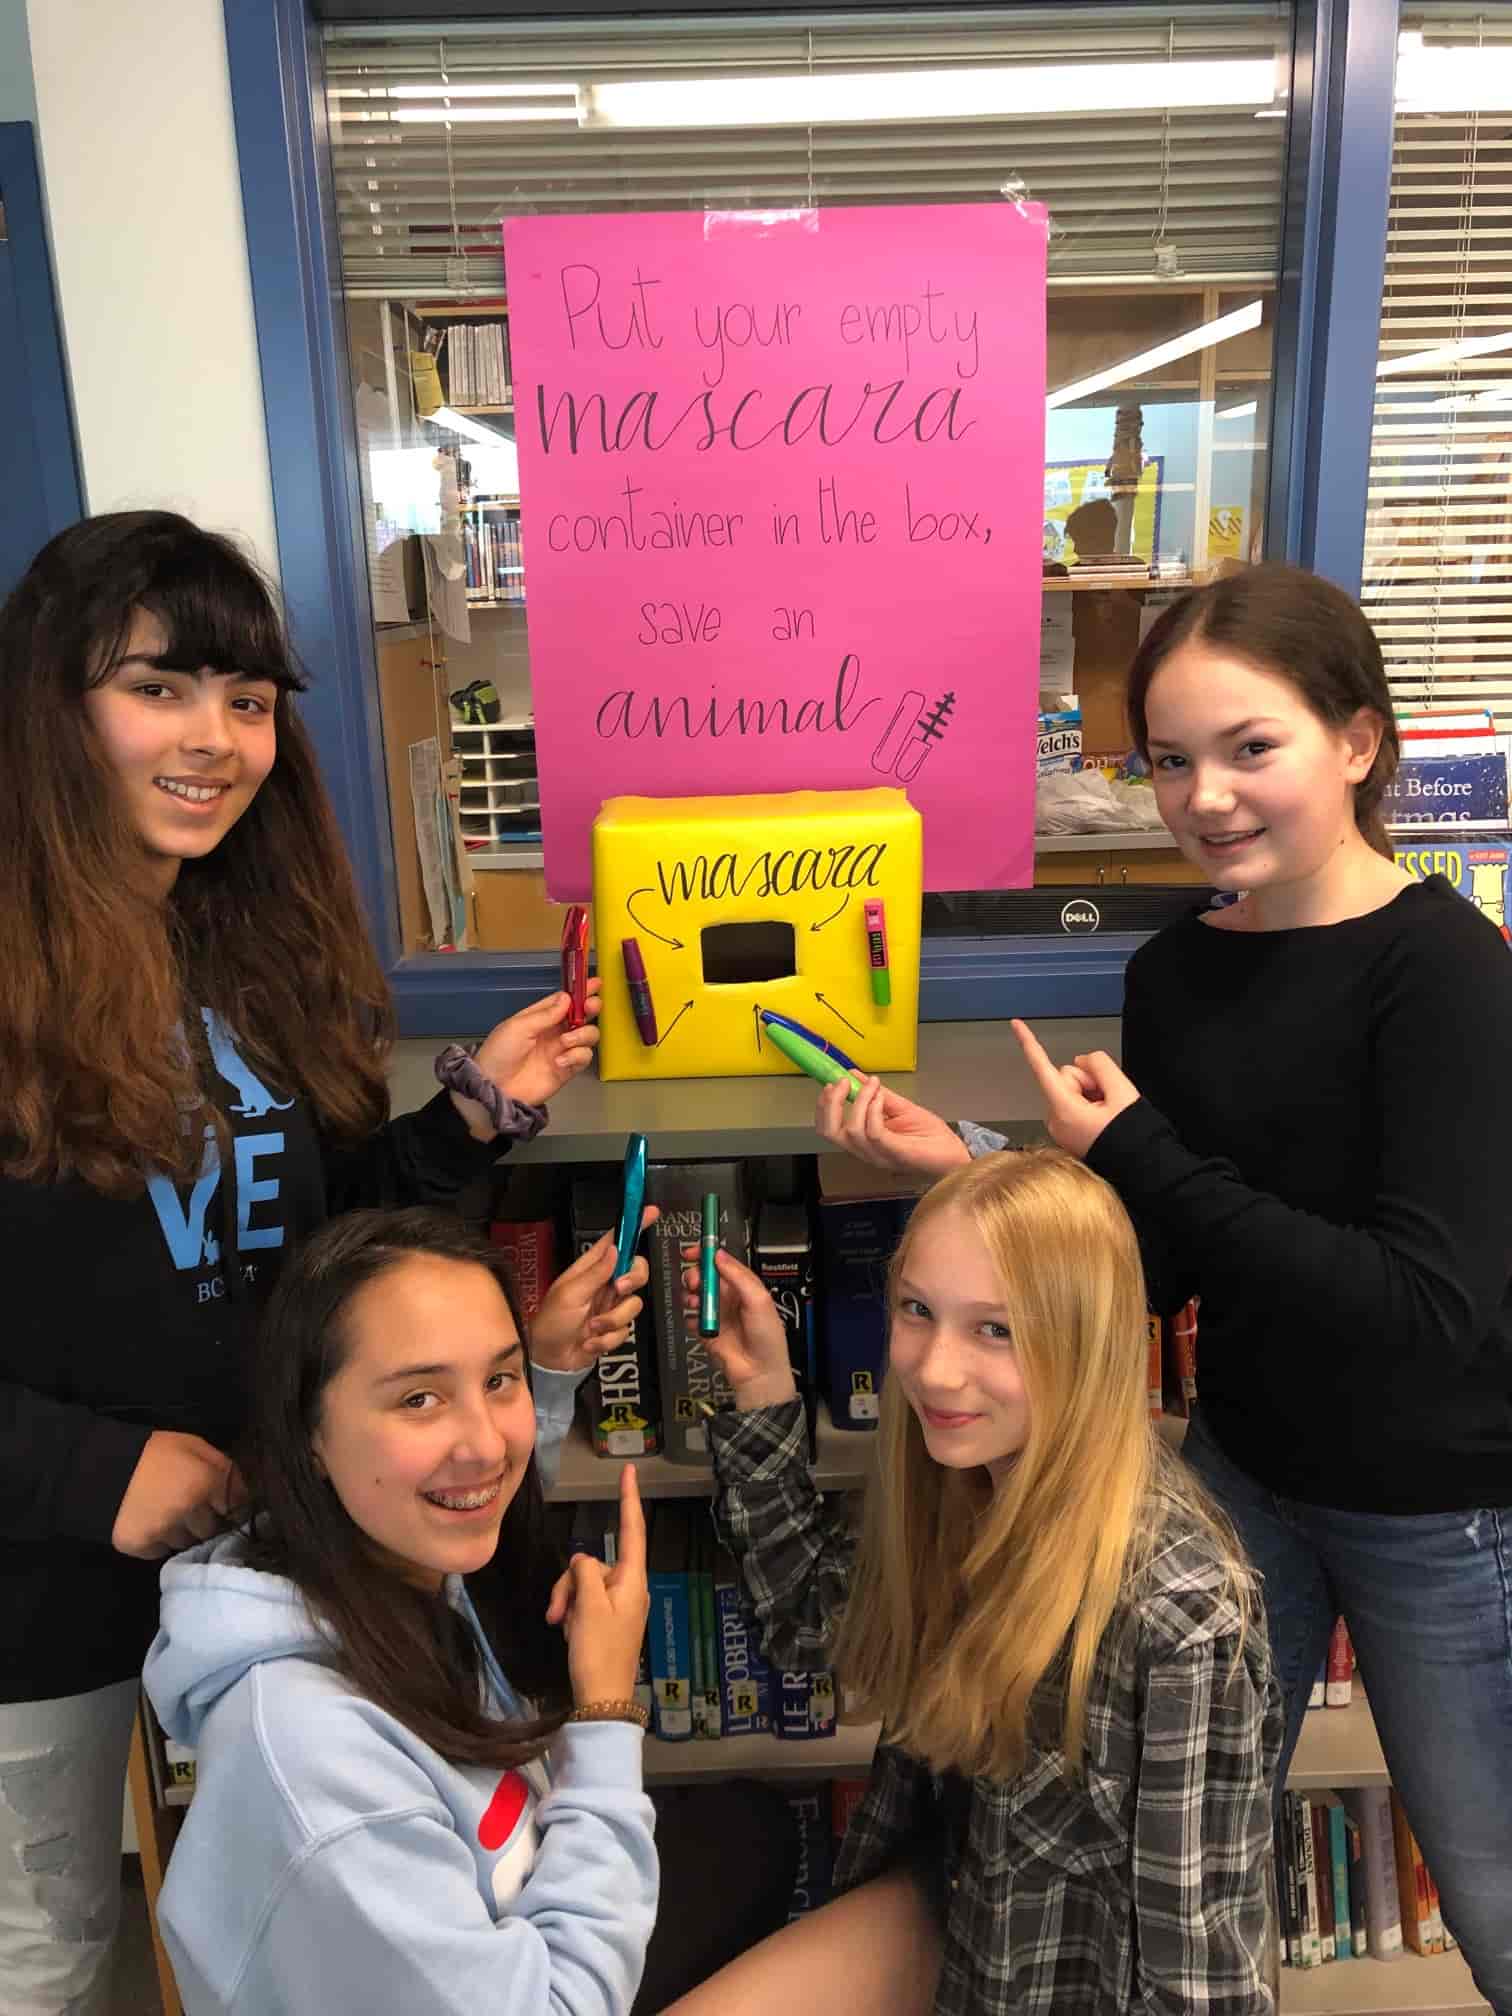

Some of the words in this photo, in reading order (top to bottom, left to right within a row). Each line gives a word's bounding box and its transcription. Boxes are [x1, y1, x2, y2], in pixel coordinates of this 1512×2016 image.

[561, 264, 663, 351] Put
[694, 302, 803, 388] your
[840, 281, 980, 378] empty
[536, 380, 977, 455] mascara
[548, 475, 743, 552] container
[773, 503, 801, 546] in
[819, 476, 878, 544] the
[906, 481, 993, 546] box,
[638, 602, 722, 645] save
[771, 607, 816, 642] an
[595, 654, 882, 739] animal
[1405, 777, 1473, 797] Before
[656, 842, 888, 906] mascara
[1065, 912, 1096, 923] DELL
[655, 1223, 703, 1239] HOUS
